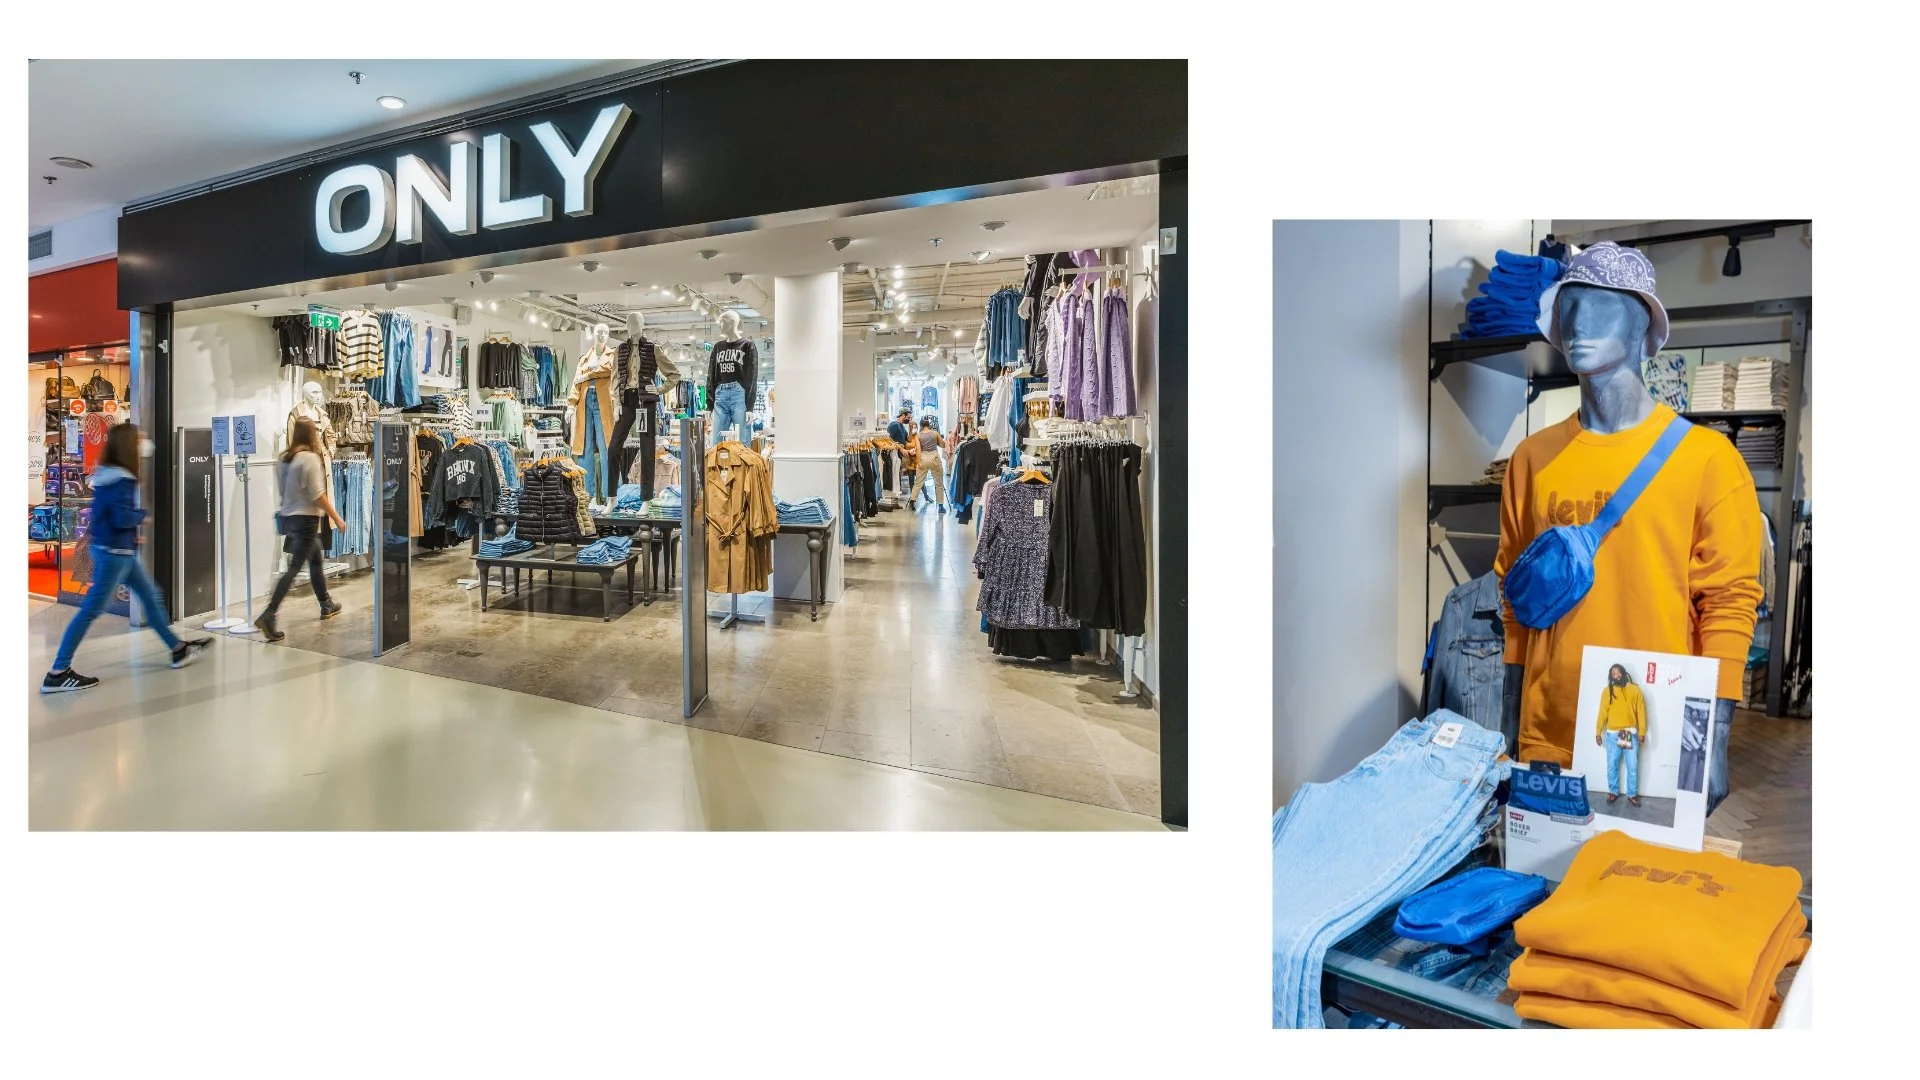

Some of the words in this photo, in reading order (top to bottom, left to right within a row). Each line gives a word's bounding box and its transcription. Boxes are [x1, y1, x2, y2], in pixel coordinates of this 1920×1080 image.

[315, 103, 632, 256] ONLY
[720, 362, 735, 373] 1996
[1548, 490, 1623, 528] levi'
[1510, 821, 1531, 831] BOXER
